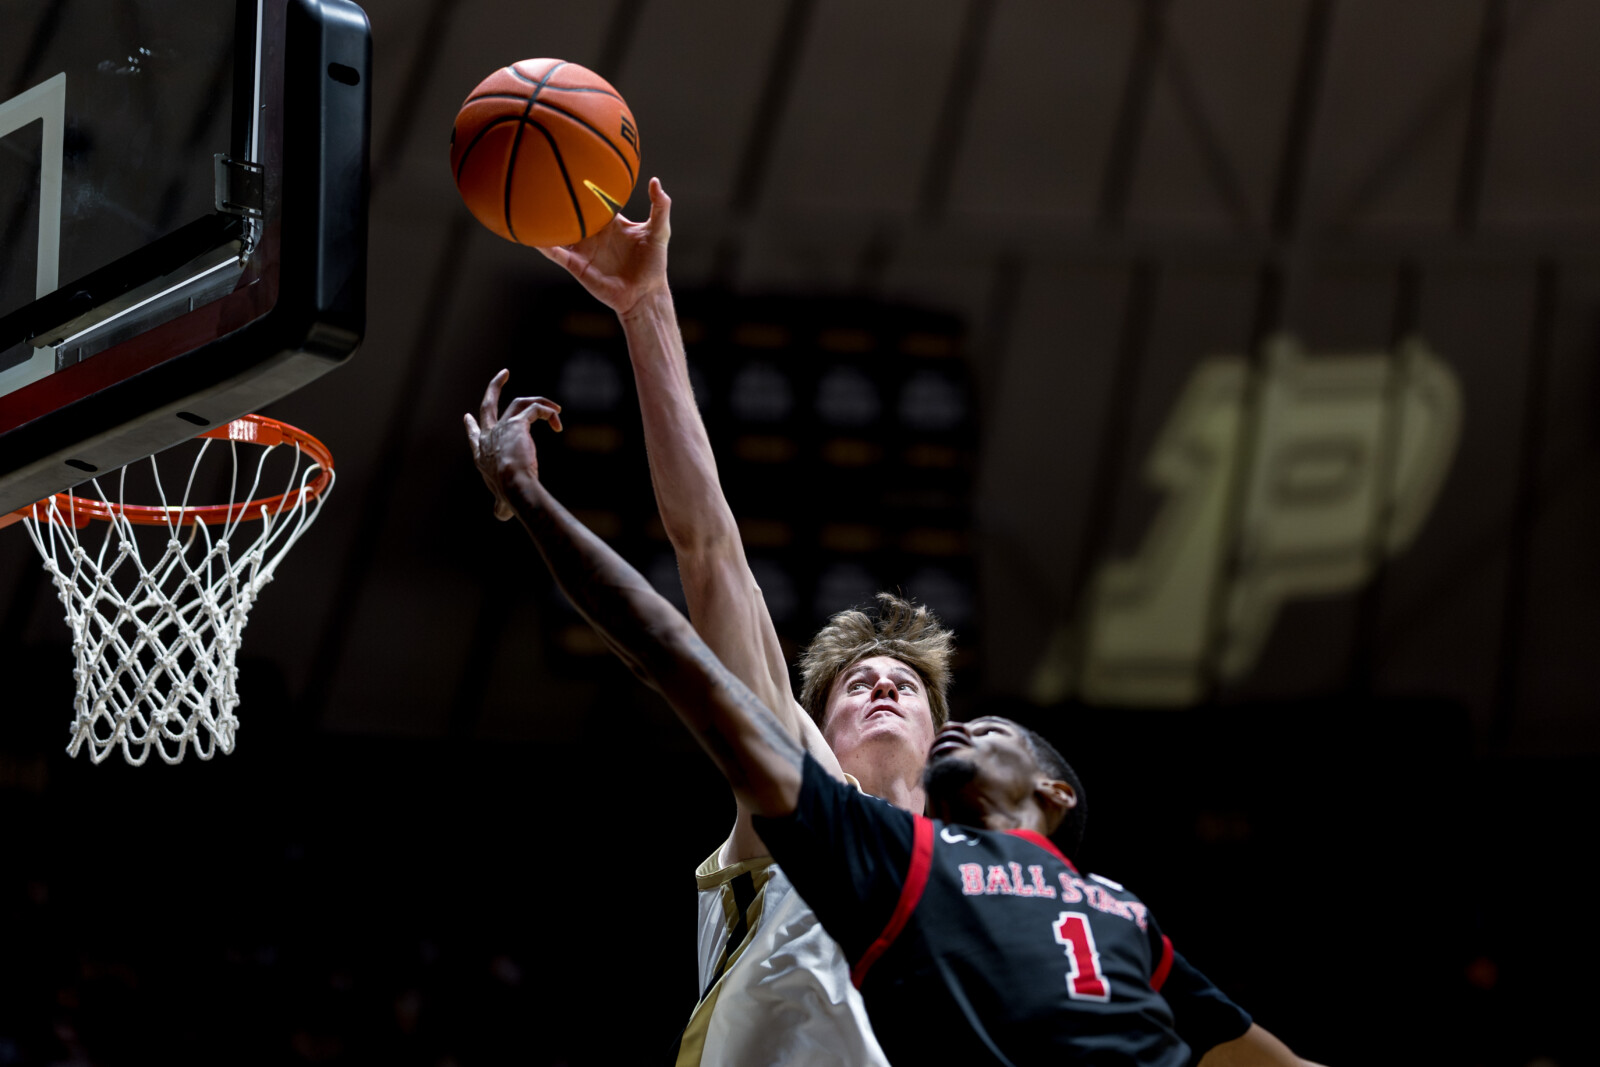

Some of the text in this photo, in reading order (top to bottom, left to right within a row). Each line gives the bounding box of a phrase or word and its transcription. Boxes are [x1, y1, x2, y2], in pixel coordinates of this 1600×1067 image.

[959, 862, 1147, 931] BALL STAT
[1052, 911, 1110, 1002] 1
